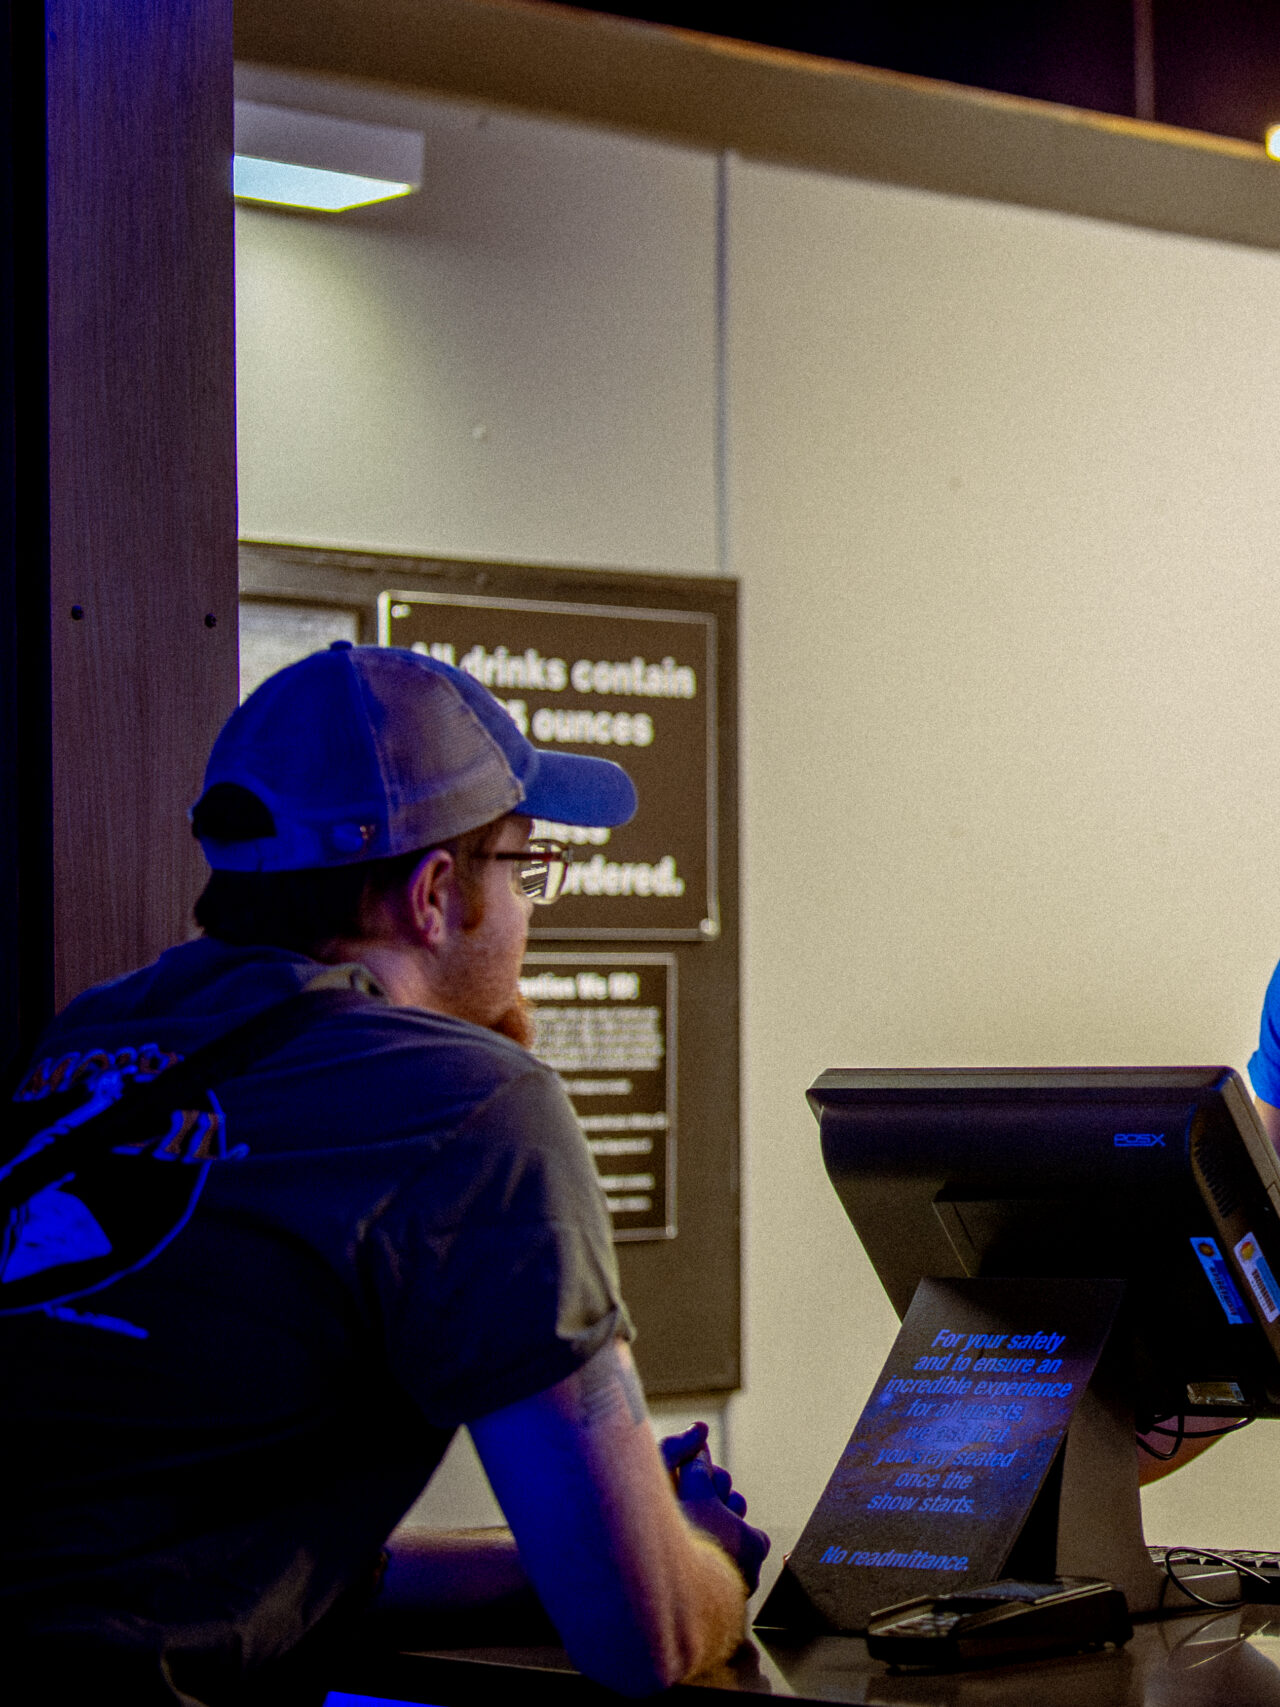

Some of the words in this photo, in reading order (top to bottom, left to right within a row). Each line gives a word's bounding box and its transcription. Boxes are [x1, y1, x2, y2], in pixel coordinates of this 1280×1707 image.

[459, 644, 568, 692] drinks
[571, 656, 696, 699] contain
[532, 707, 655, 748] ounces
[931, 1329, 964, 1348] For
[961, 1332, 1008, 1352] your
[1007, 1331, 1066, 1354] safety
[913, 1353, 953, 1371] and
[951, 1354, 972, 1372] to
[973, 1358, 1036, 1373] ensure
[1035, 1358, 1063, 1374] an
[884, 1375, 973, 1395] incredible
[973, 1378, 1073, 1398] experience
[906, 1399, 937, 1417] for
[935, 1400, 962, 1417] all
[904, 1425, 932, 1441] we
[872, 1448, 911, 1466] you
[911, 1449, 953, 1469] stay
[952, 1449, 1018, 1468] seated
[895, 1472, 941, 1488] once
[942, 1471, 974, 1490] the
[867, 1491, 918, 1510] show
[918, 1495, 975, 1513] starts.
[819, 1545, 848, 1564] No
[848, 1548, 969, 1571] readmittance.
